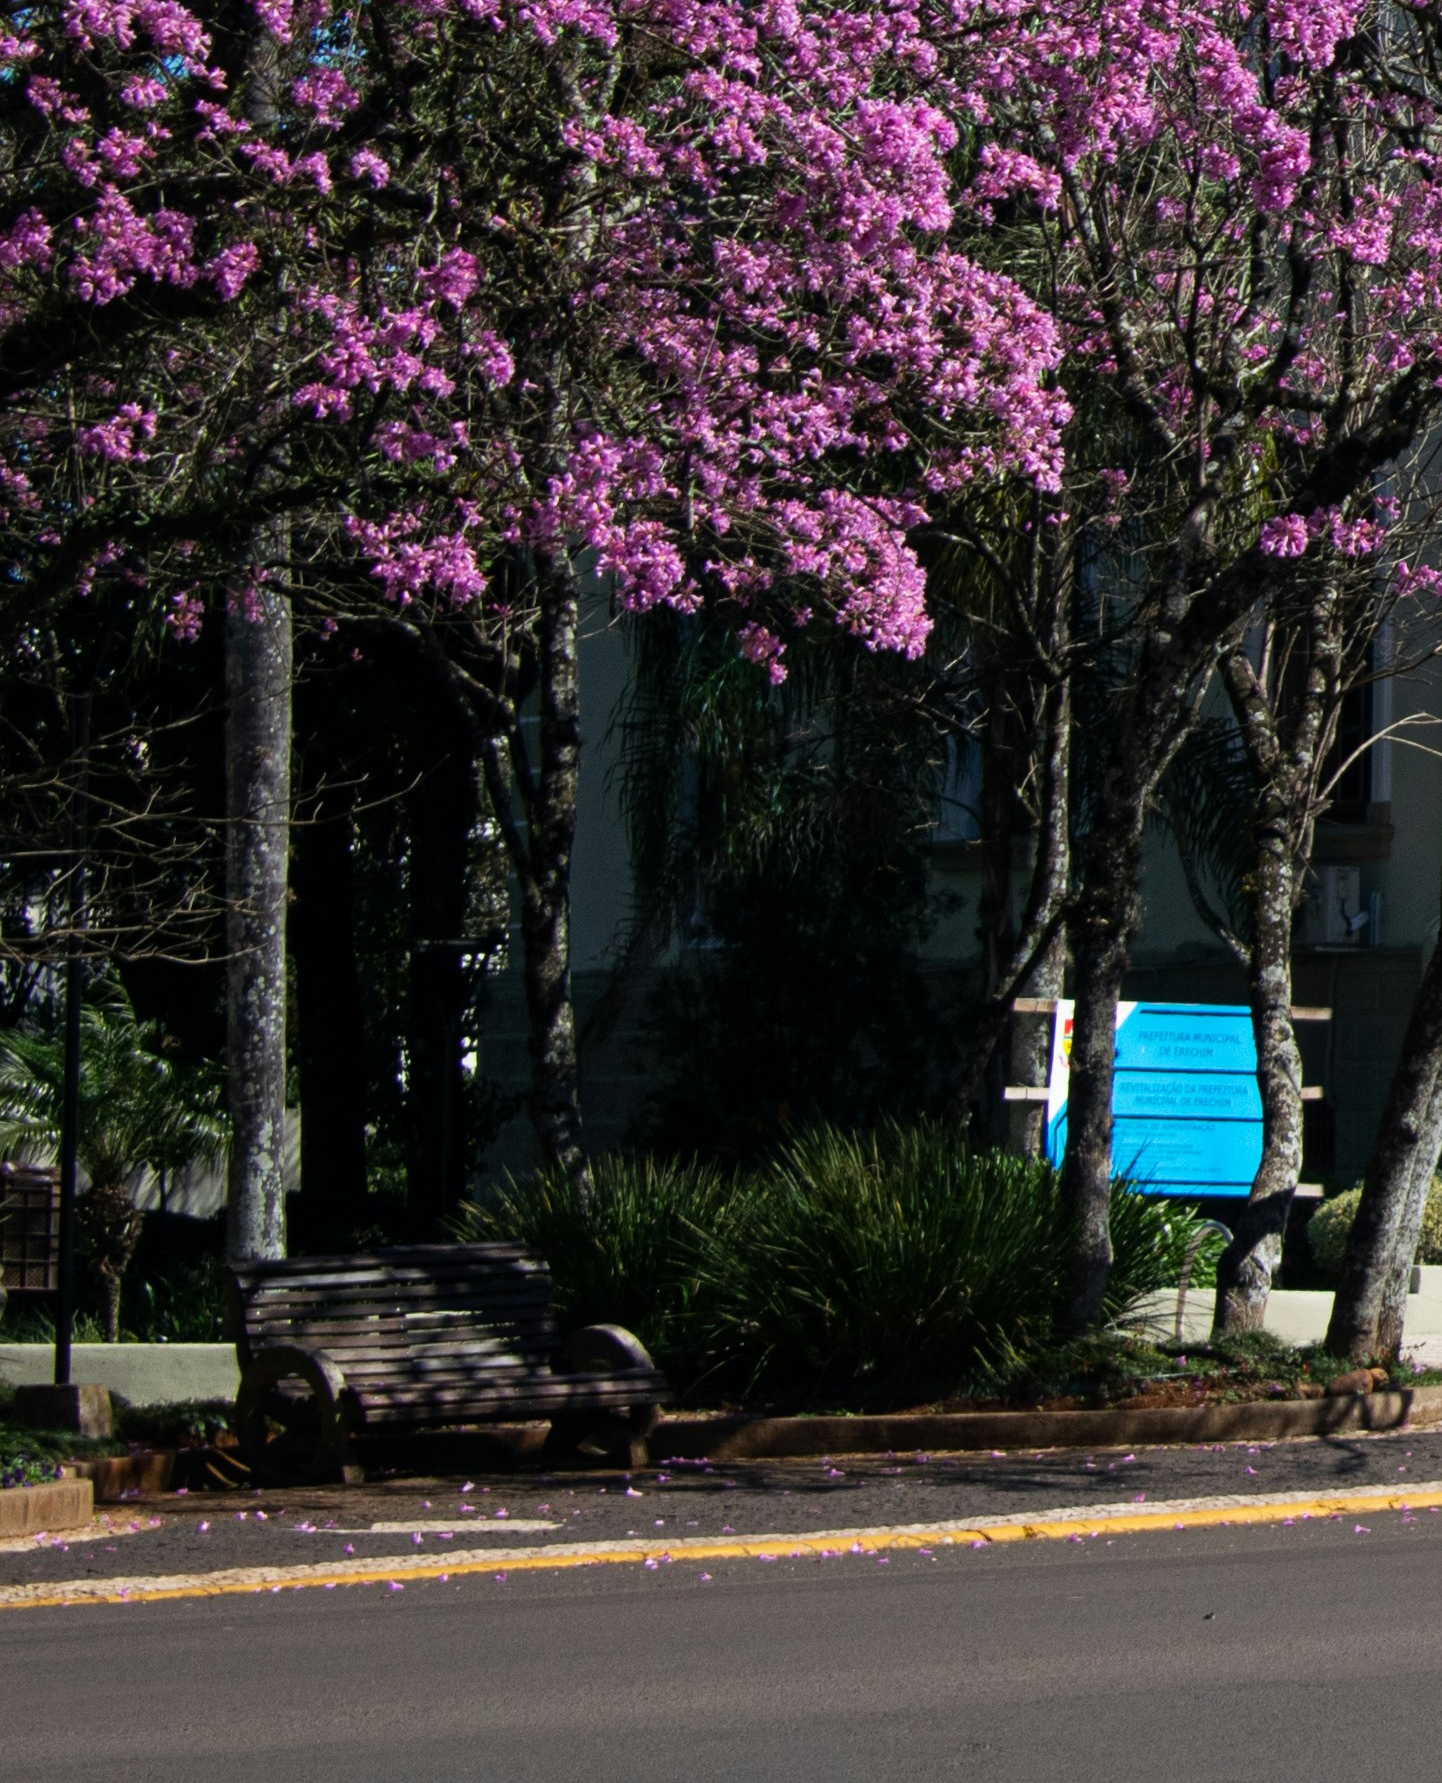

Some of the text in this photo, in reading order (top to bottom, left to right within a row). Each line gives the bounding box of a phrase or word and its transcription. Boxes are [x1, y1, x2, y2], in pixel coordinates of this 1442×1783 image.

[1138, 1031, 1241, 1044] PREFEITURA MUNICIPAL
[1159, 1046, 1214, 1057] DE ERECHIM
[1121, 1081, 1248, 1095] REVITALIZAÇÃO DA PREFEITURA
[1135, 1096, 1232, 1107] MUNICIPAL DE ERECHIM
